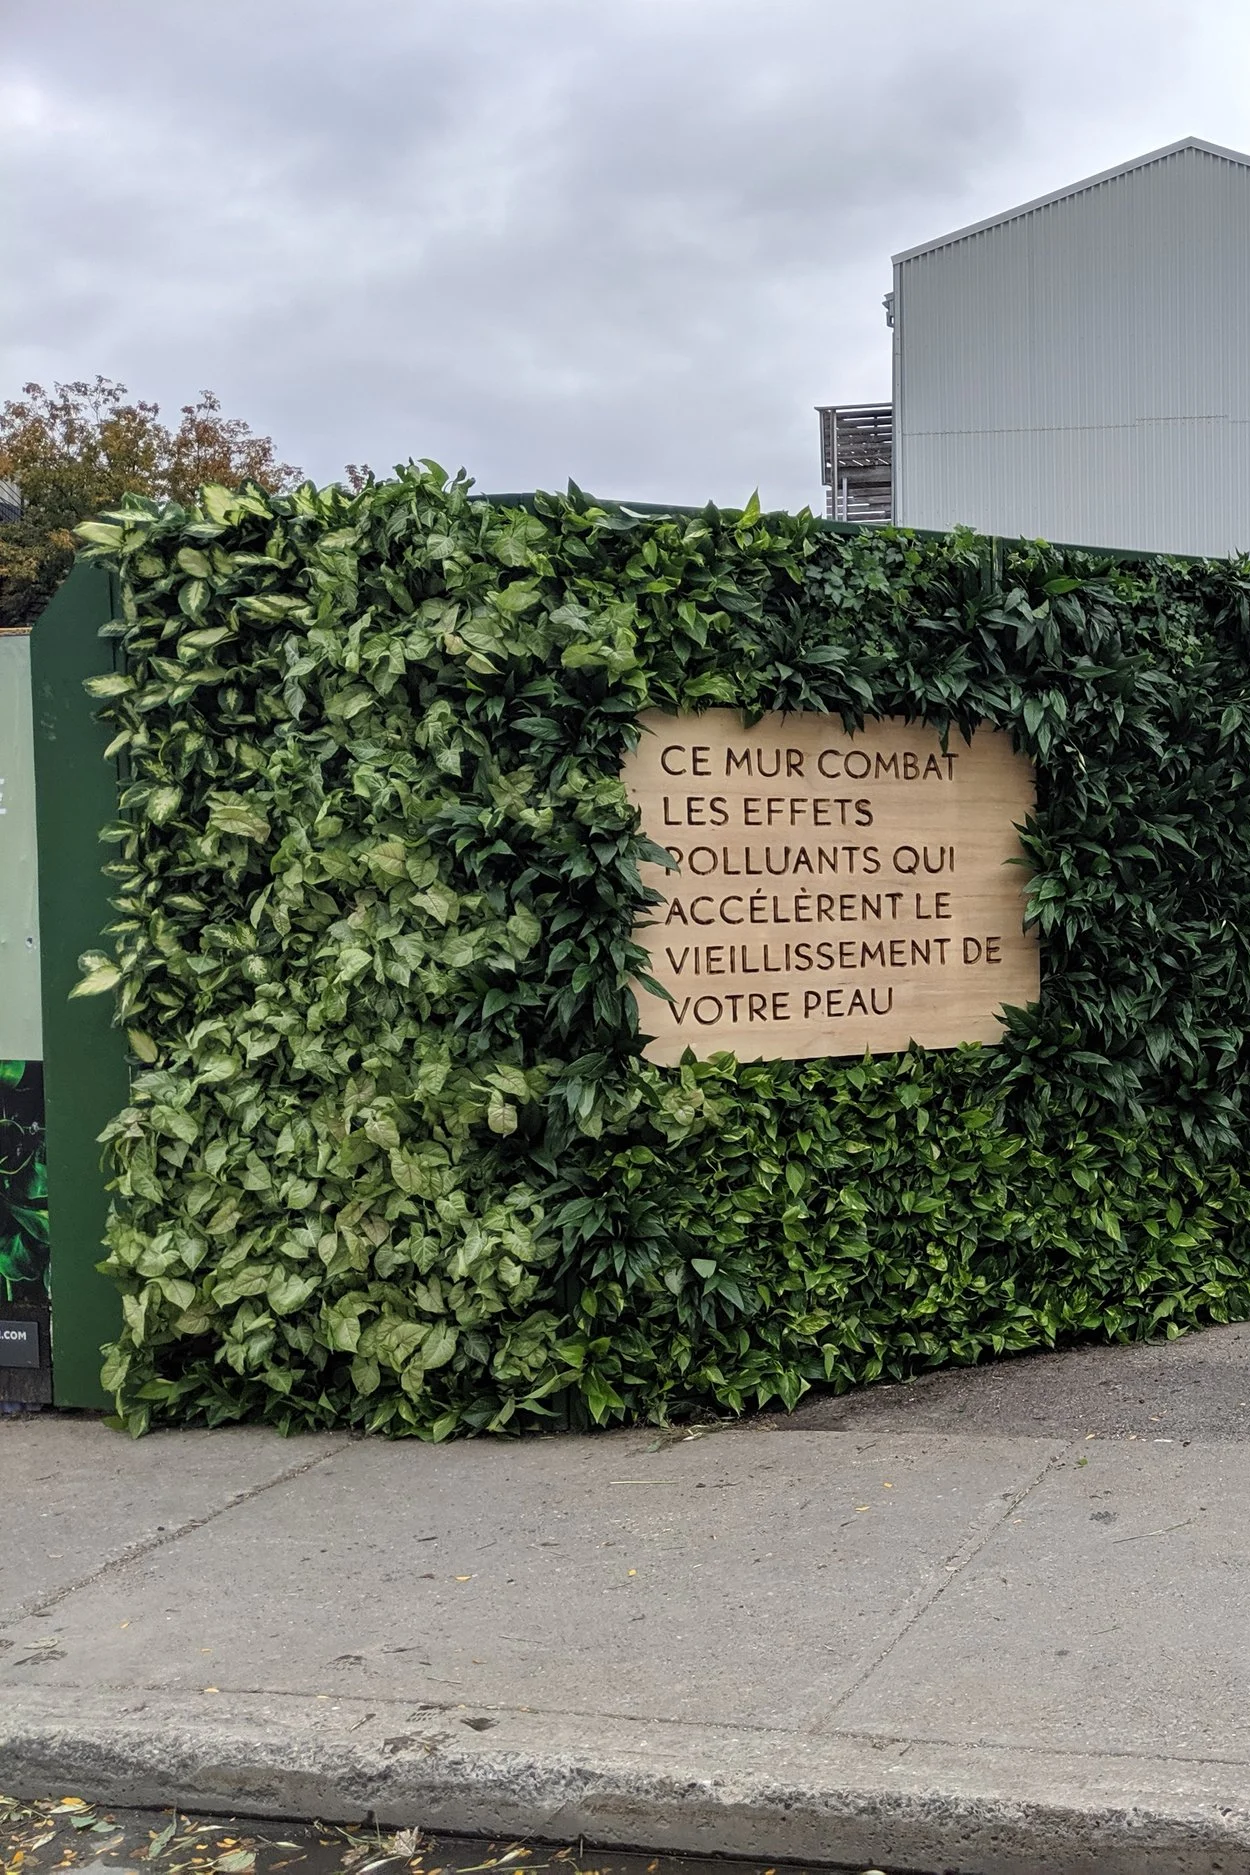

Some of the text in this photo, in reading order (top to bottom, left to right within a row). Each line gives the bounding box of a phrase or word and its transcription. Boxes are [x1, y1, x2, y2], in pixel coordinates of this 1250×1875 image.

[660, 745, 959, 781] CE MUR COMBAT
[663, 796, 875, 828] LES EFFETS
[665, 846, 956, 876] POLLUANTS QUI
[665, 887, 953, 926] ACCÉLÈRENT LE
[665, 935, 1002, 976] VIEILLISSEMENT DE
[668, 986, 894, 1027] VOTRE PEAU
